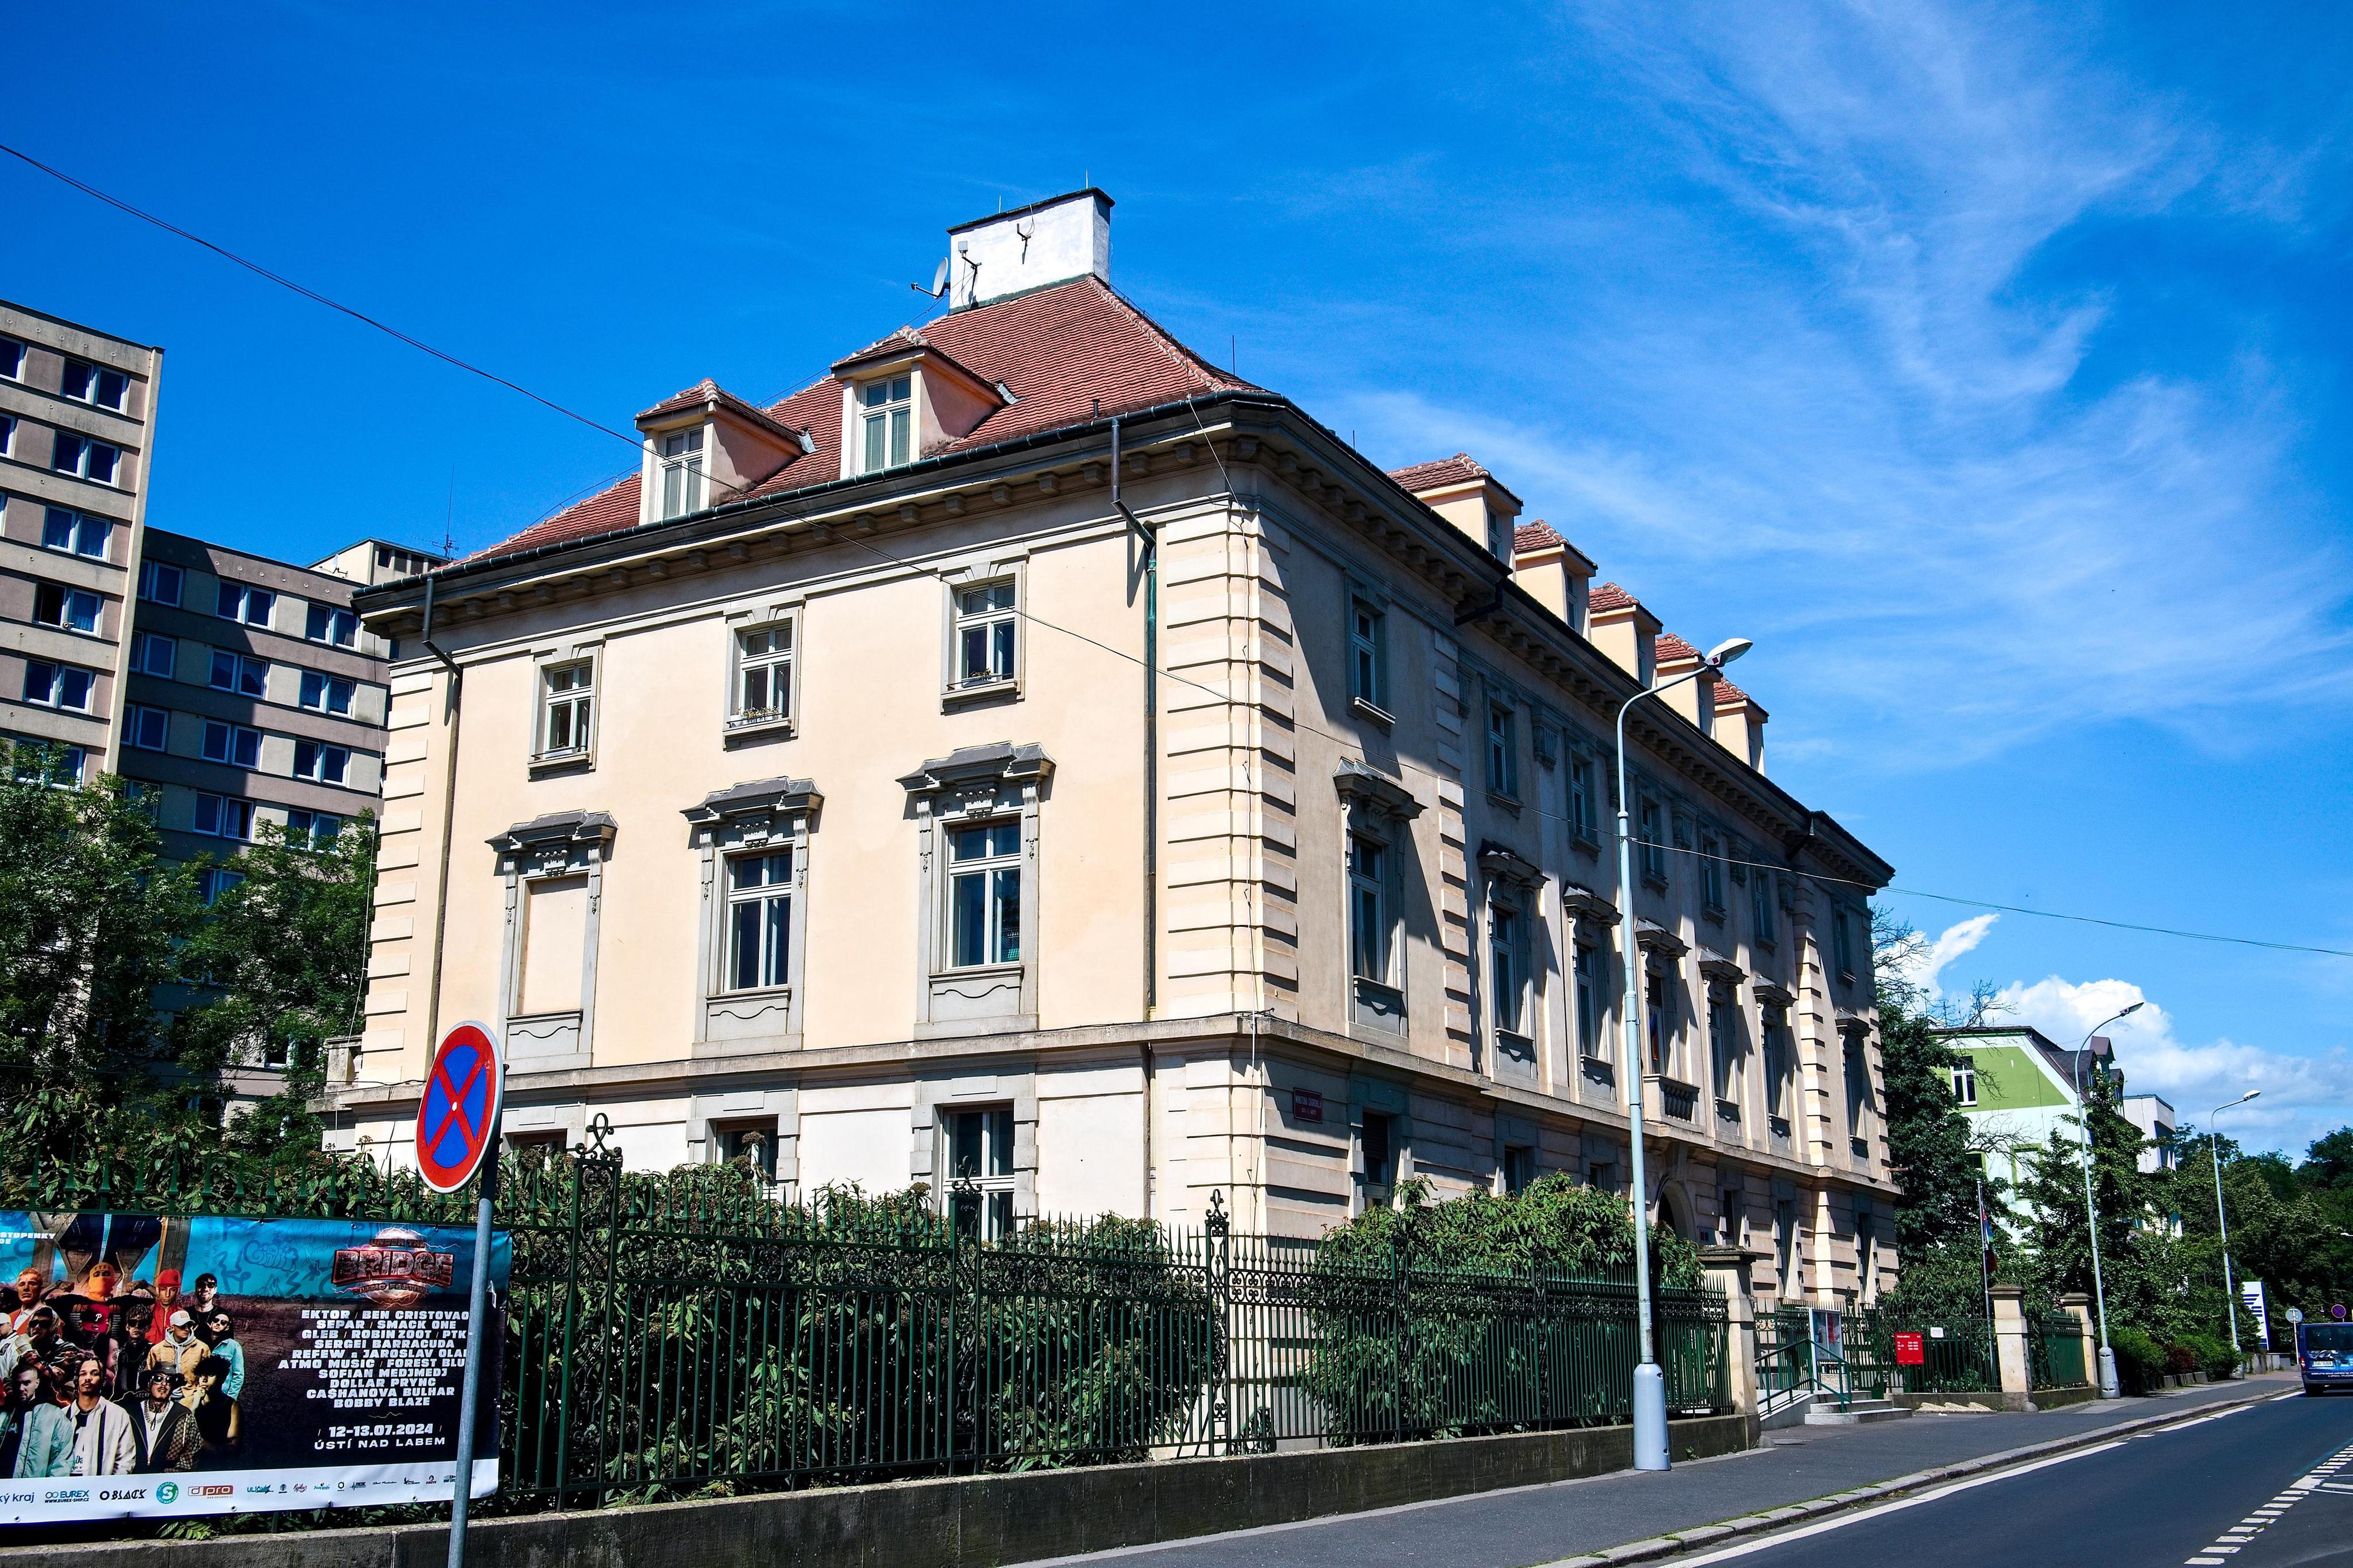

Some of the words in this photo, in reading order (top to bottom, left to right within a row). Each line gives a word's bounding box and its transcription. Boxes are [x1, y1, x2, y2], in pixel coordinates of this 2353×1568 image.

[302, 1310, 350, 1319] EKTOR
[395, 1311, 469, 1320] CRISTOVAO
[316, 1320, 365, 1329] SEPAR
[377, 1320, 426, 1329] SMACK
[432, 1320, 456, 1329] ONE
[302, 1330, 338, 1339] GLEB
[352, 1330, 395, 1339] ROBIN
[398, 1330, 431, 1339] ZOOT
[315, 1340, 366, 1349] SERGEI
[372, 1340, 454, 1348] BARRACUDA
[292, 1350, 345, 1359] REFEW
[363, 1349, 434, 1358] JAROSLAV
[278, 1359, 322, 1369] ATMO
[328, 1359, 375, 1368] MUSIC
[387, 1359, 437, 1367] FOREST
[319, 1369, 373, 1378] SOFIAN
[379, 1368, 447, 1377] MEDJMEDJ
[330, 1379, 385, 1388] DOLLAR
[391, 1378, 436, 1387] PRYNC
[306, 1388, 397, 1399] CA$HANOVA
[403, 1387, 454, 1396] BULHAR
[333, 1398, 383, 1407] BOBBY
[389, 1397, 430, 1406] BLAZE
[329, 1423, 433, 1437] 12-13.07.2024
[315, 1439, 352, 1449] ÚSTÍ
[396, 1437, 445, 1446] LABEM
[12, 1492, 35, 1503] kraj
